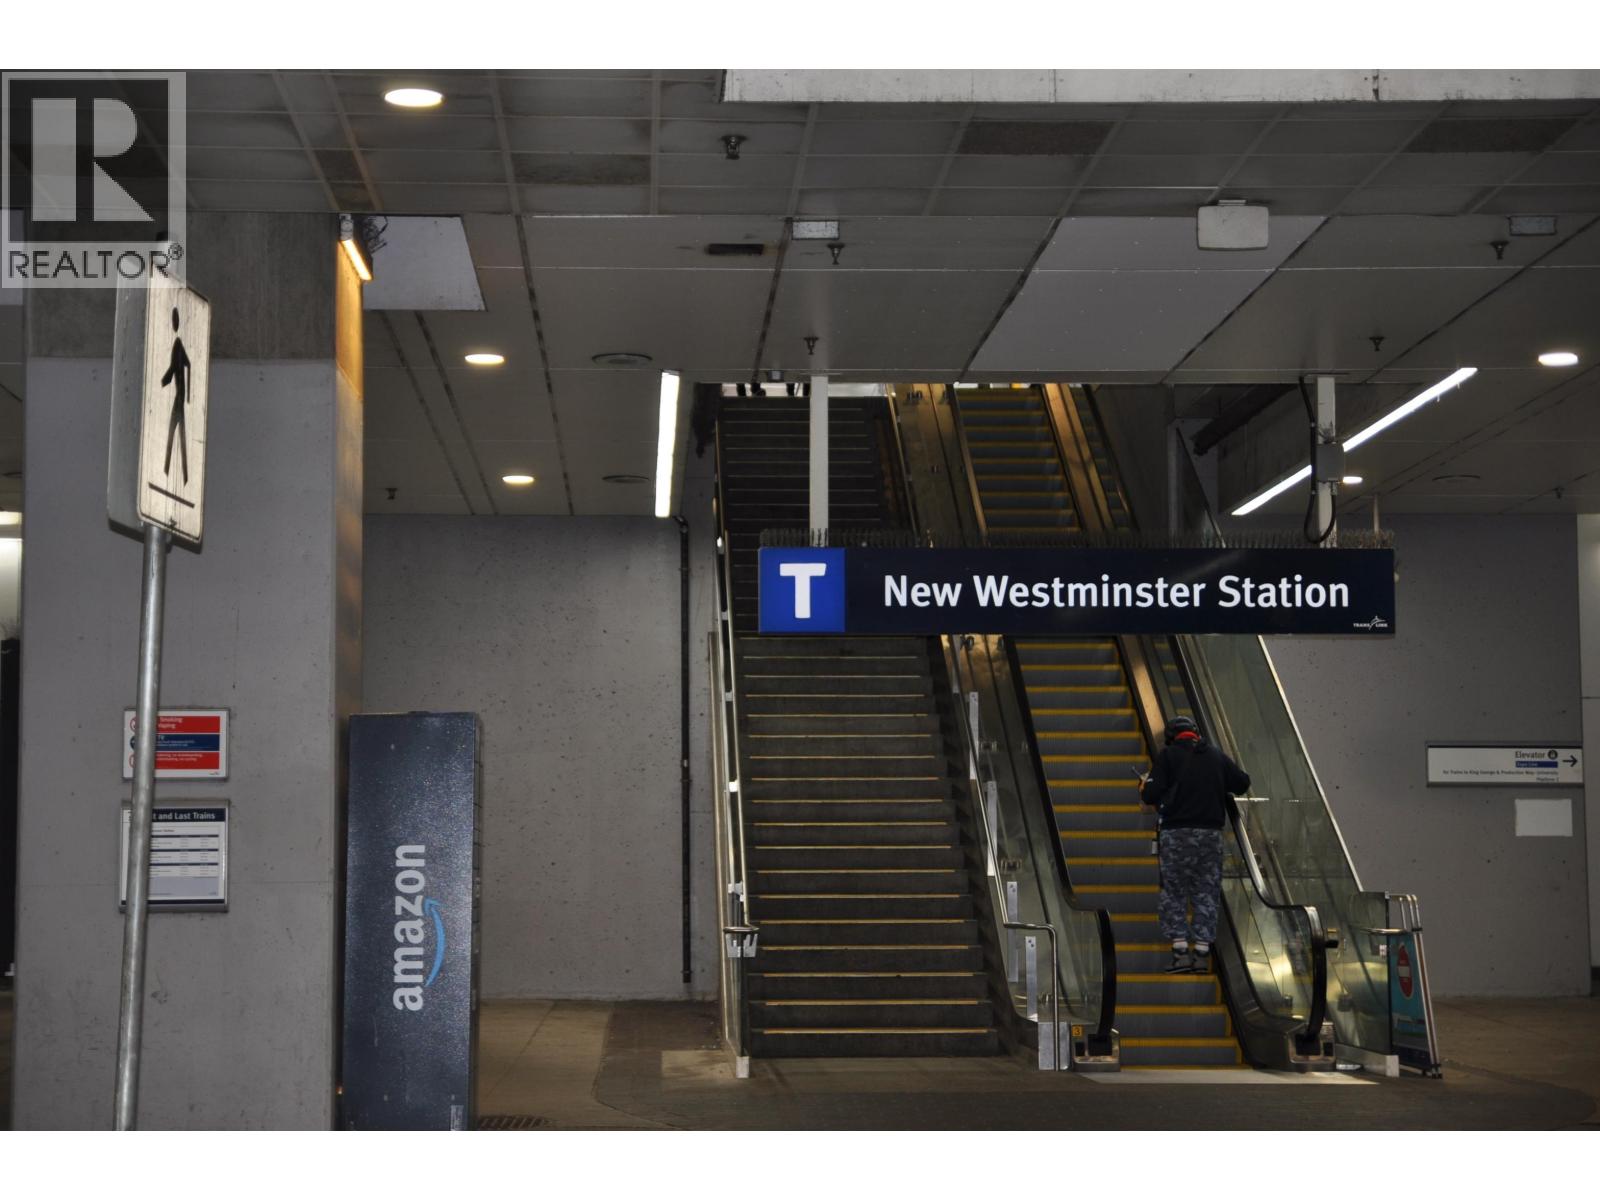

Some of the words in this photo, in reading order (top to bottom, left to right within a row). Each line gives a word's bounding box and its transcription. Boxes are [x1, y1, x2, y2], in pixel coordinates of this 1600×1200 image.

[780, 563, 827, 619] T
[884, 574, 962, 607] New
[973, 573, 1206, 608] Westminster
[1218, 573, 1349, 608] Station
[1515, 751, 1545, 759] Elevator
[158, 812, 173, 820] and
[174, 812, 191, 820] Last
[193, 811, 216, 820] Trains
[393, 845, 426, 1011] amazon
